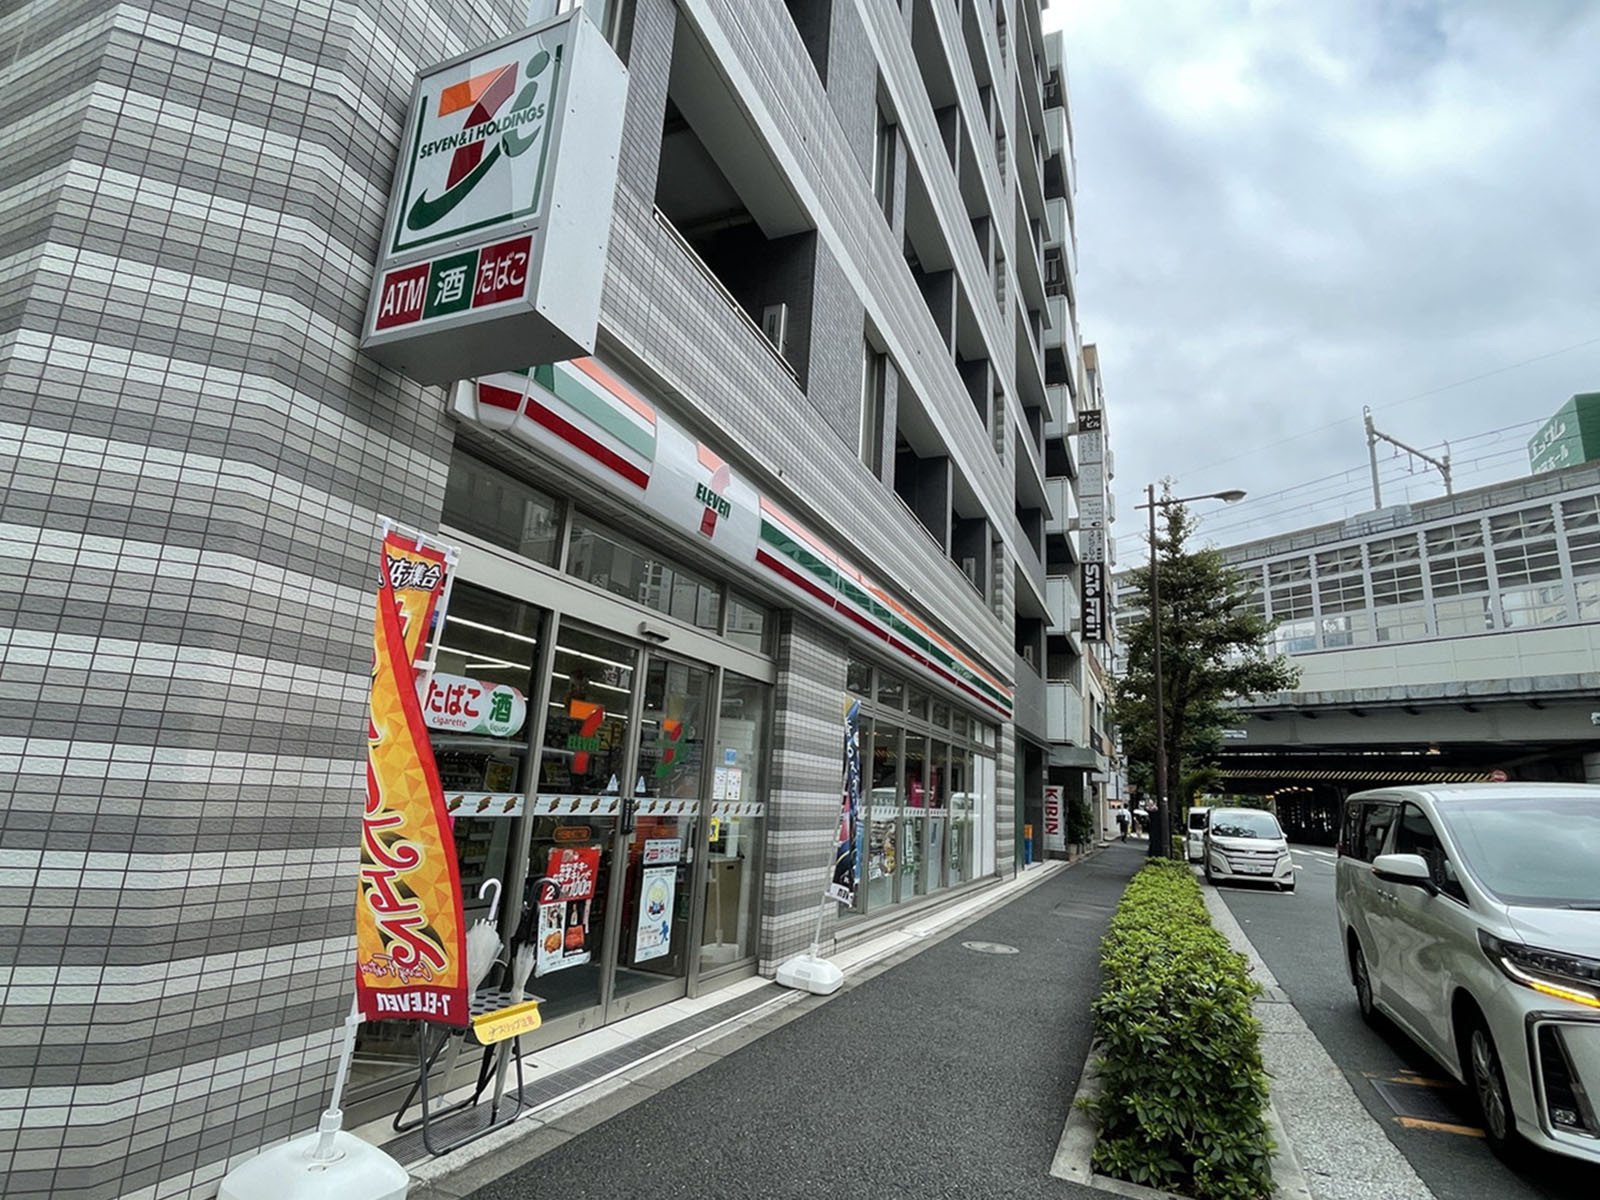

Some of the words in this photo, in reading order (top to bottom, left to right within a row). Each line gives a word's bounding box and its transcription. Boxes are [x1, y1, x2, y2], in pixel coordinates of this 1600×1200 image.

[477, 103, 546, 142] HOLDINGS
[433, 264, 469, 308] 酒
[476, 251, 526, 296] たばこ
[381, 276, 425, 318] ATM
[424, 679, 482, 718] たばこ
[489, 690, 514, 724] 酒
[1044, 787, 1060, 836] KIRIN
